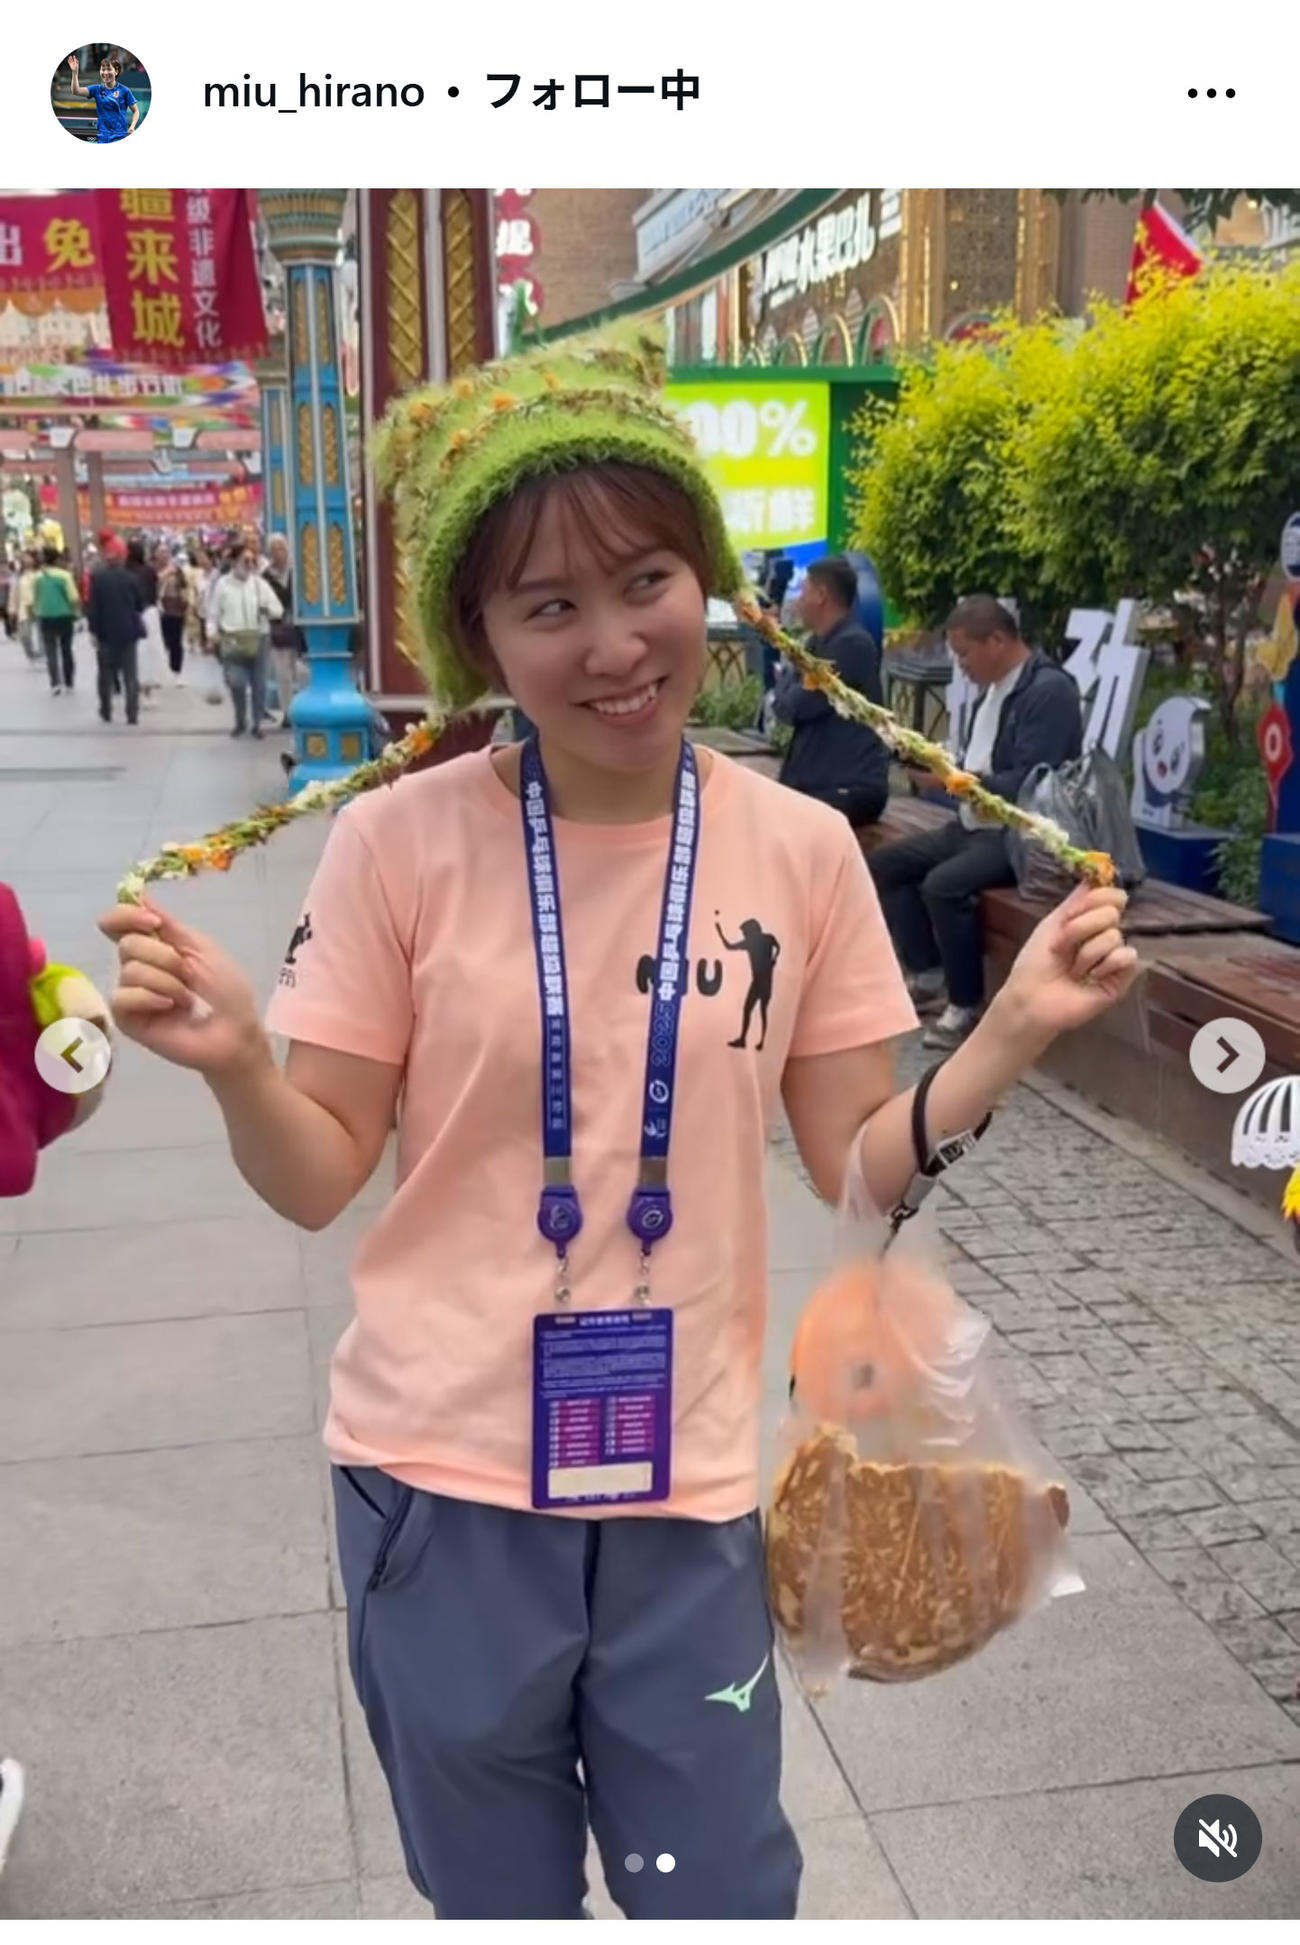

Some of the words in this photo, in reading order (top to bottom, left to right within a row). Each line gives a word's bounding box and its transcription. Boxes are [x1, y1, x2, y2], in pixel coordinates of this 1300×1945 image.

[43, 218, 96, 273] 免
[185, 189, 223, 348] 级非遗文化
[664, 398, 818, 459] 00%
